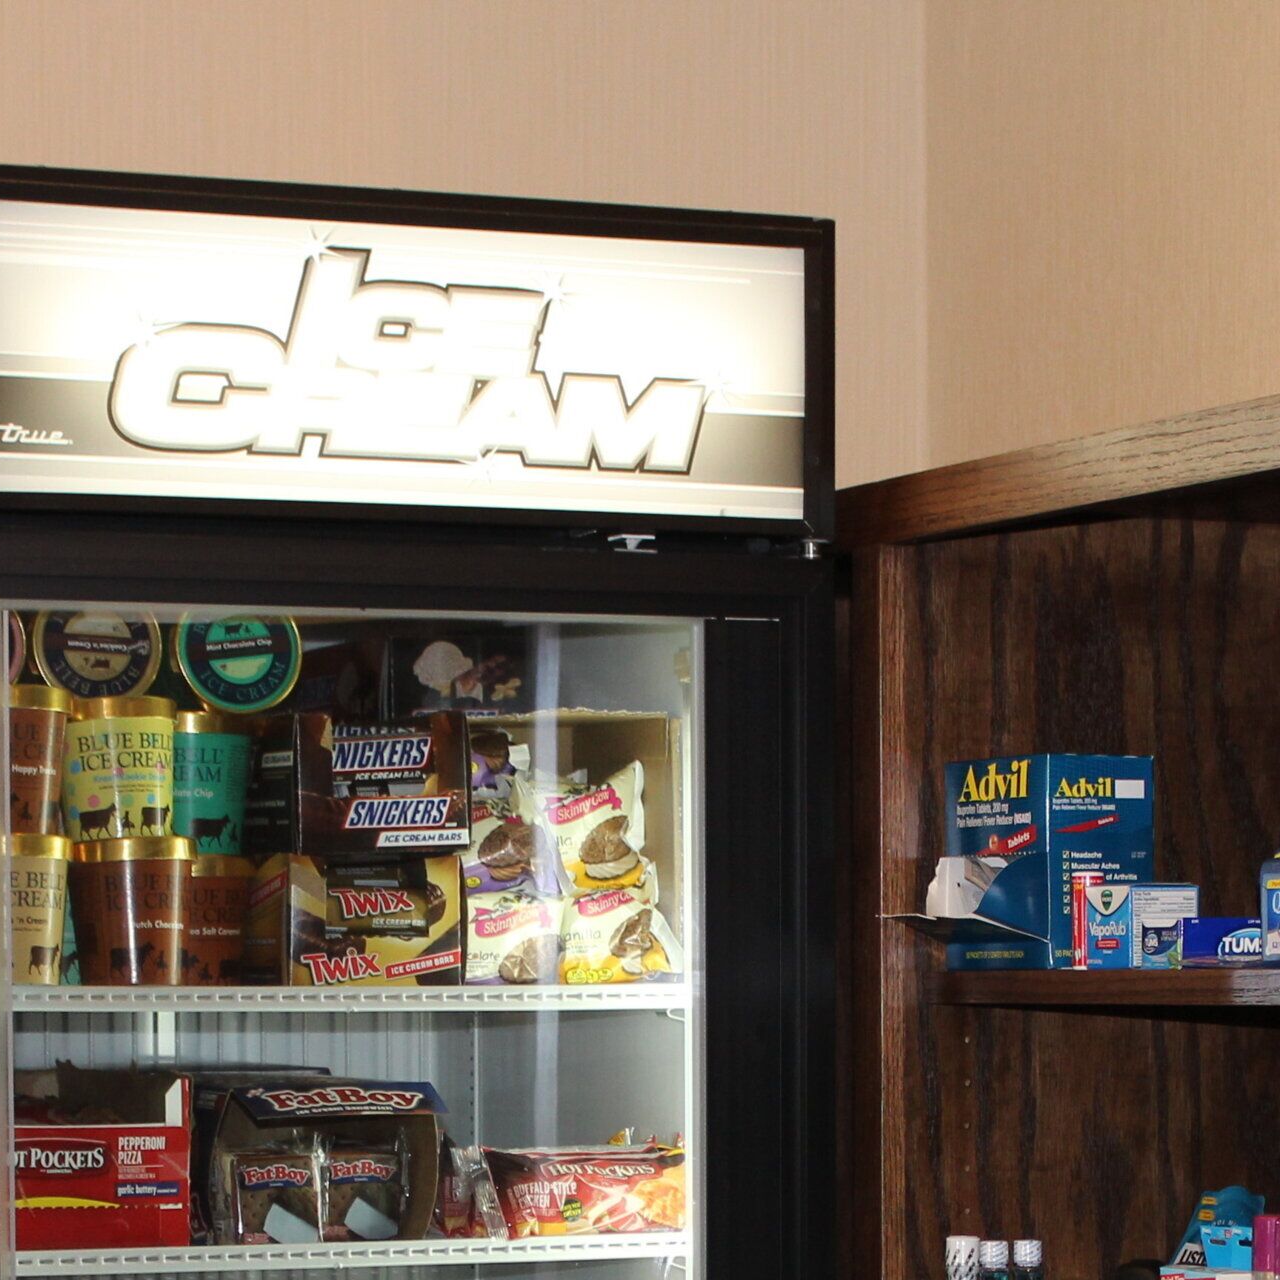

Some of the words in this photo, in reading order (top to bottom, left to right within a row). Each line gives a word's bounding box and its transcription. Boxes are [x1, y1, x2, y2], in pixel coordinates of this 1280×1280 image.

[223, 641, 255, 650] Chocolate
[257, 639, 273, 647] Chip
[77, 732, 133, 753] BLUE
[332, 736, 431, 772] NICKERS
[80, 754, 113, 772] ICE
[12, 766, 37, 778] Happy
[355, 772, 372, 781] ICE
[373, 772, 403, 781] CREAM
[958, 759, 1028, 802] Advil
[193, 788, 214, 799] Chip
[1054, 777, 1112, 797] Advil
[347, 797, 450, 828] SNICKERS
[383, 834, 402, 843] ICE
[403, 833, 436, 843] CREAM
[437, 831, 463, 842] BARS
[1071, 851, 1102, 859] Headache
[1071, 862, 1100, 870] Muscular
[1101, 862, 1120, 870] Aches
[1105, 873, 1112, 881] of
[1113, 873, 1138, 881] Arthritis
[329, 888, 415, 918] Twix
[1088, 921, 1126, 937] VapoRub
[301, 949, 383, 985] Twix
[390, 965, 403, 975] ICE
[404, 961, 431, 973] CREAM
[432, 955, 456, 968] BARS
[263, 1088, 424, 1111] FatBoy
[118, 1136, 166, 1150] PEPPERONI
[30, 1146, 105, 1170] POCKETS
[118, 1151, 143, 1164] PIZZA
[243, 1164, 311, 1186] FatBoy
[331, 1159, 396, 1182] FatBoy
[585, 1164, 655, 1180] POCKETS
[135, 1184, 157, 1196] buttery
